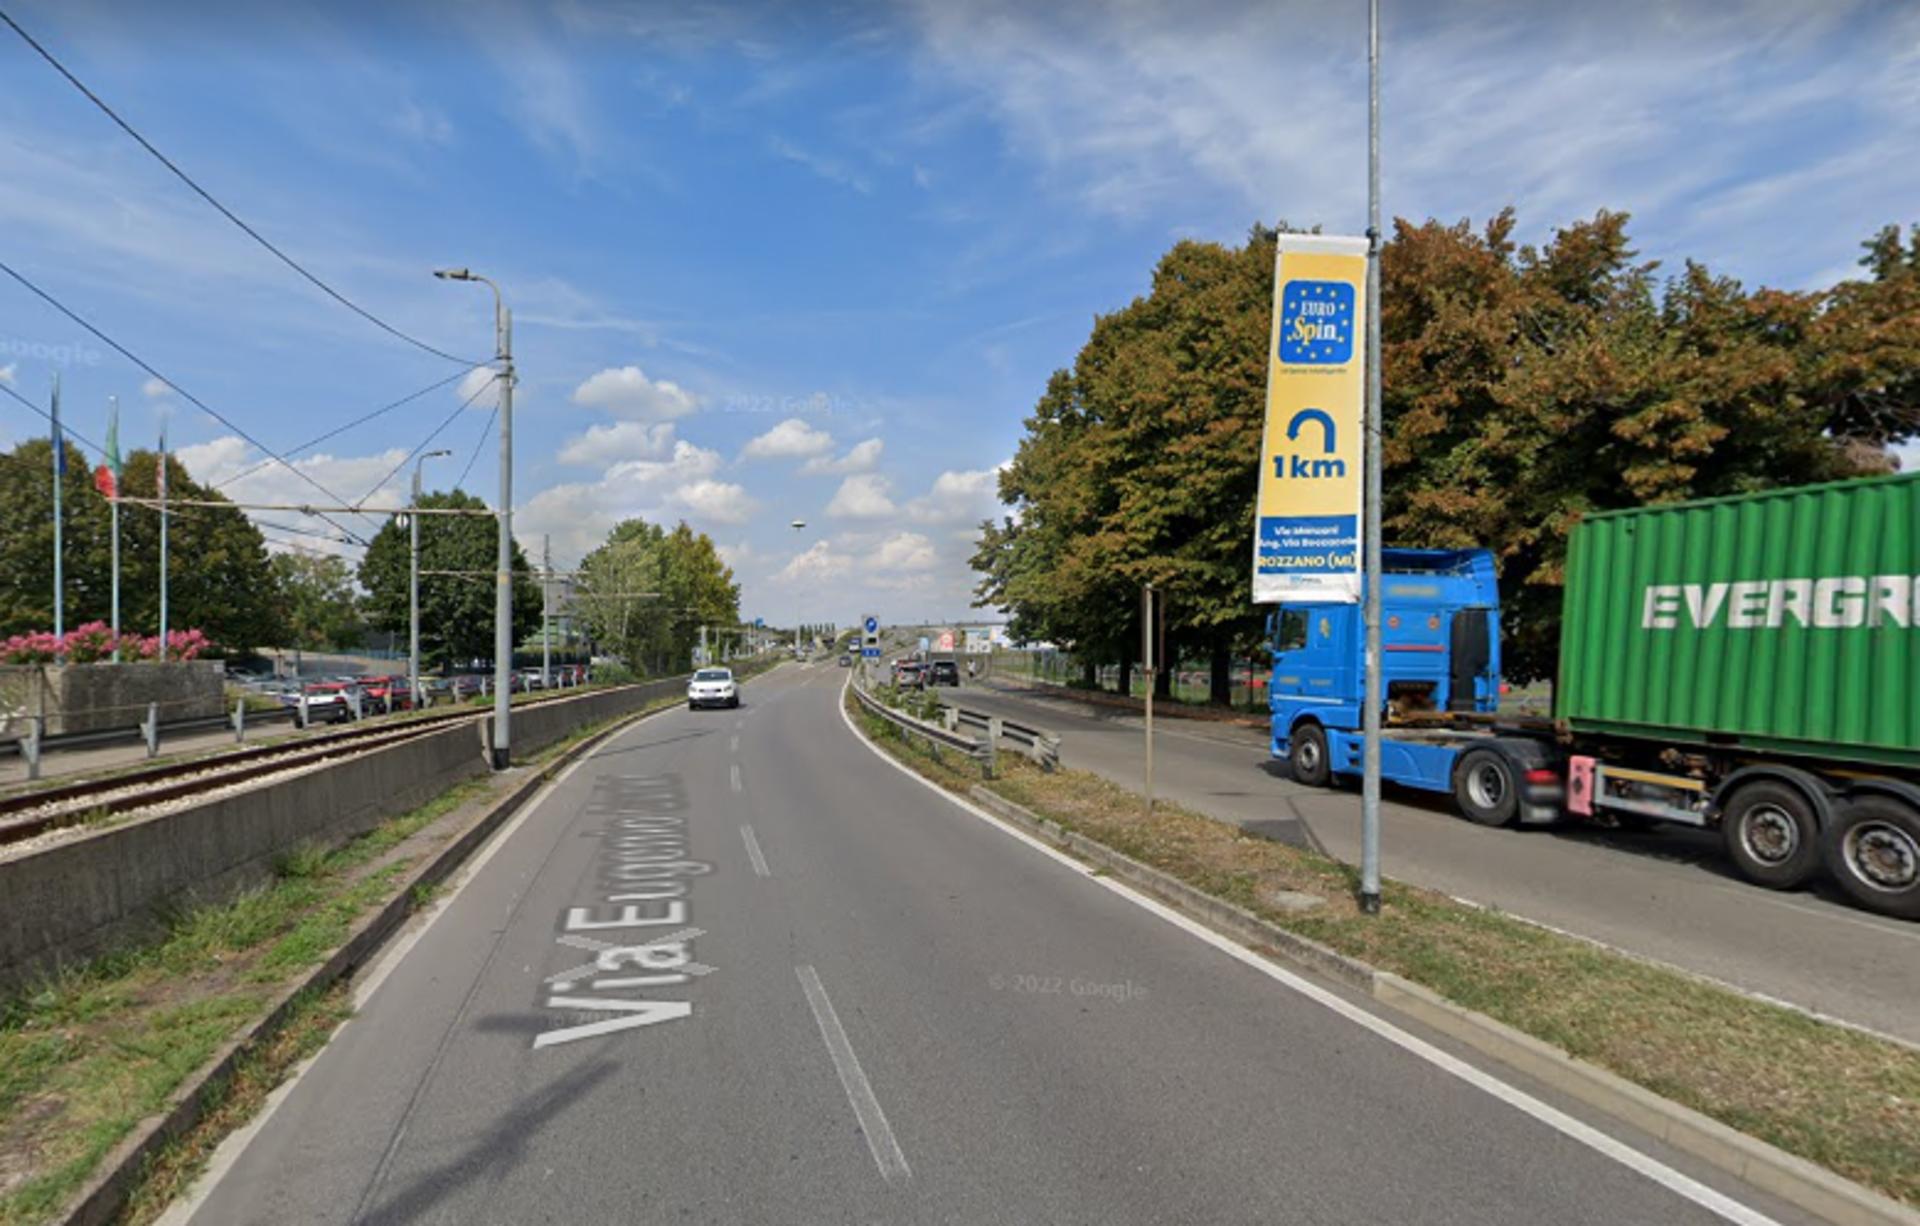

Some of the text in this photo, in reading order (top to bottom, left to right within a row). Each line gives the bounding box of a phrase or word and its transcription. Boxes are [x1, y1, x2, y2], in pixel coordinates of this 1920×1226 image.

[1301, 301, 1335, 316] EURO
[1292, 316, 1338, 346] Spin
[1258, 555, 1325, 567] ROZZANO
[1641, 574, 1920, 629] EVERGR
[566, 813, 712, 930] Eugenio
[533, 942, 692, 1050] Via
